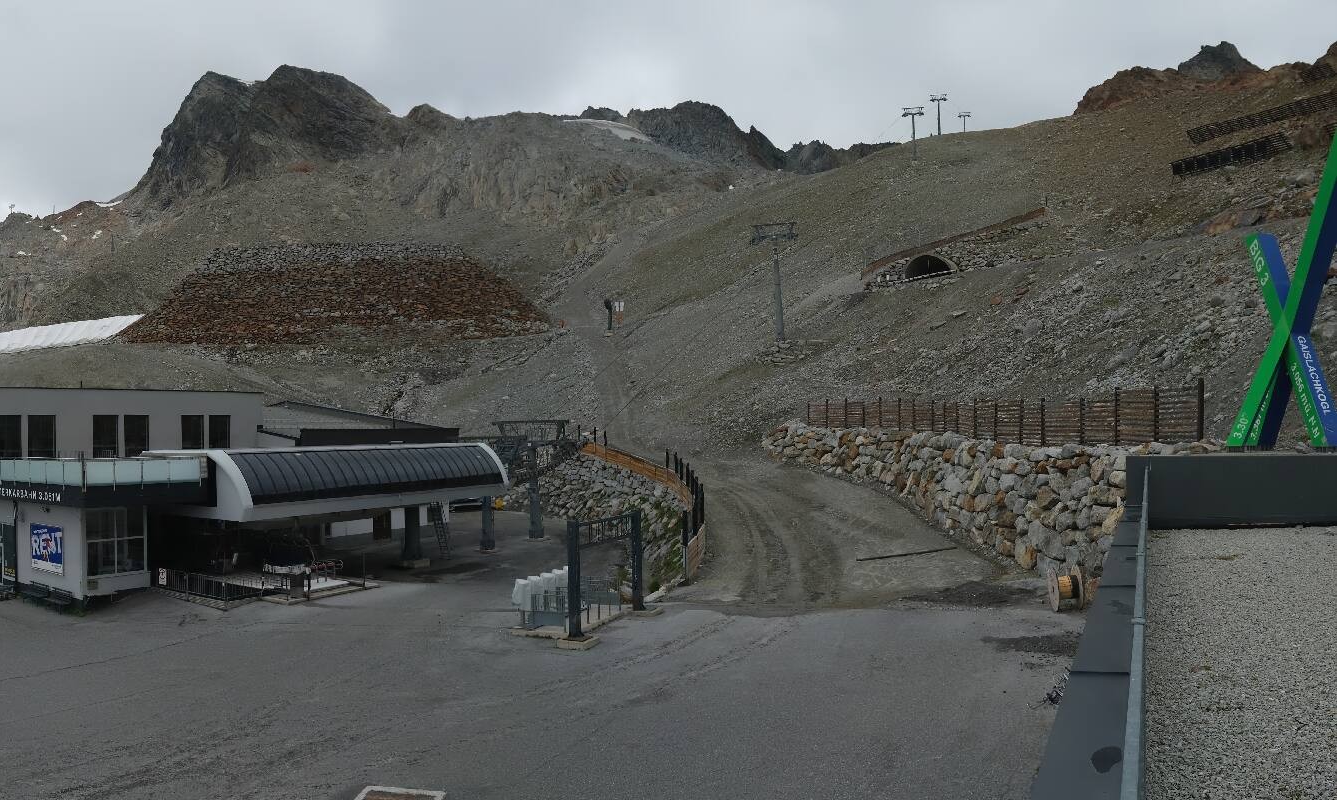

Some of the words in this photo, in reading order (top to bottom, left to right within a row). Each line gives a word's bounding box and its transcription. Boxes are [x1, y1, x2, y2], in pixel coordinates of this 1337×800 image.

[1249, 238, 1265, 273] BIG
[1260, 272, 1269, 287] 3
[1297, 335, 1331, 416] GAISLACHKOGL
[1233, 411, 1249, 440] 3.30
[31, 531, 63, 556] RENT
